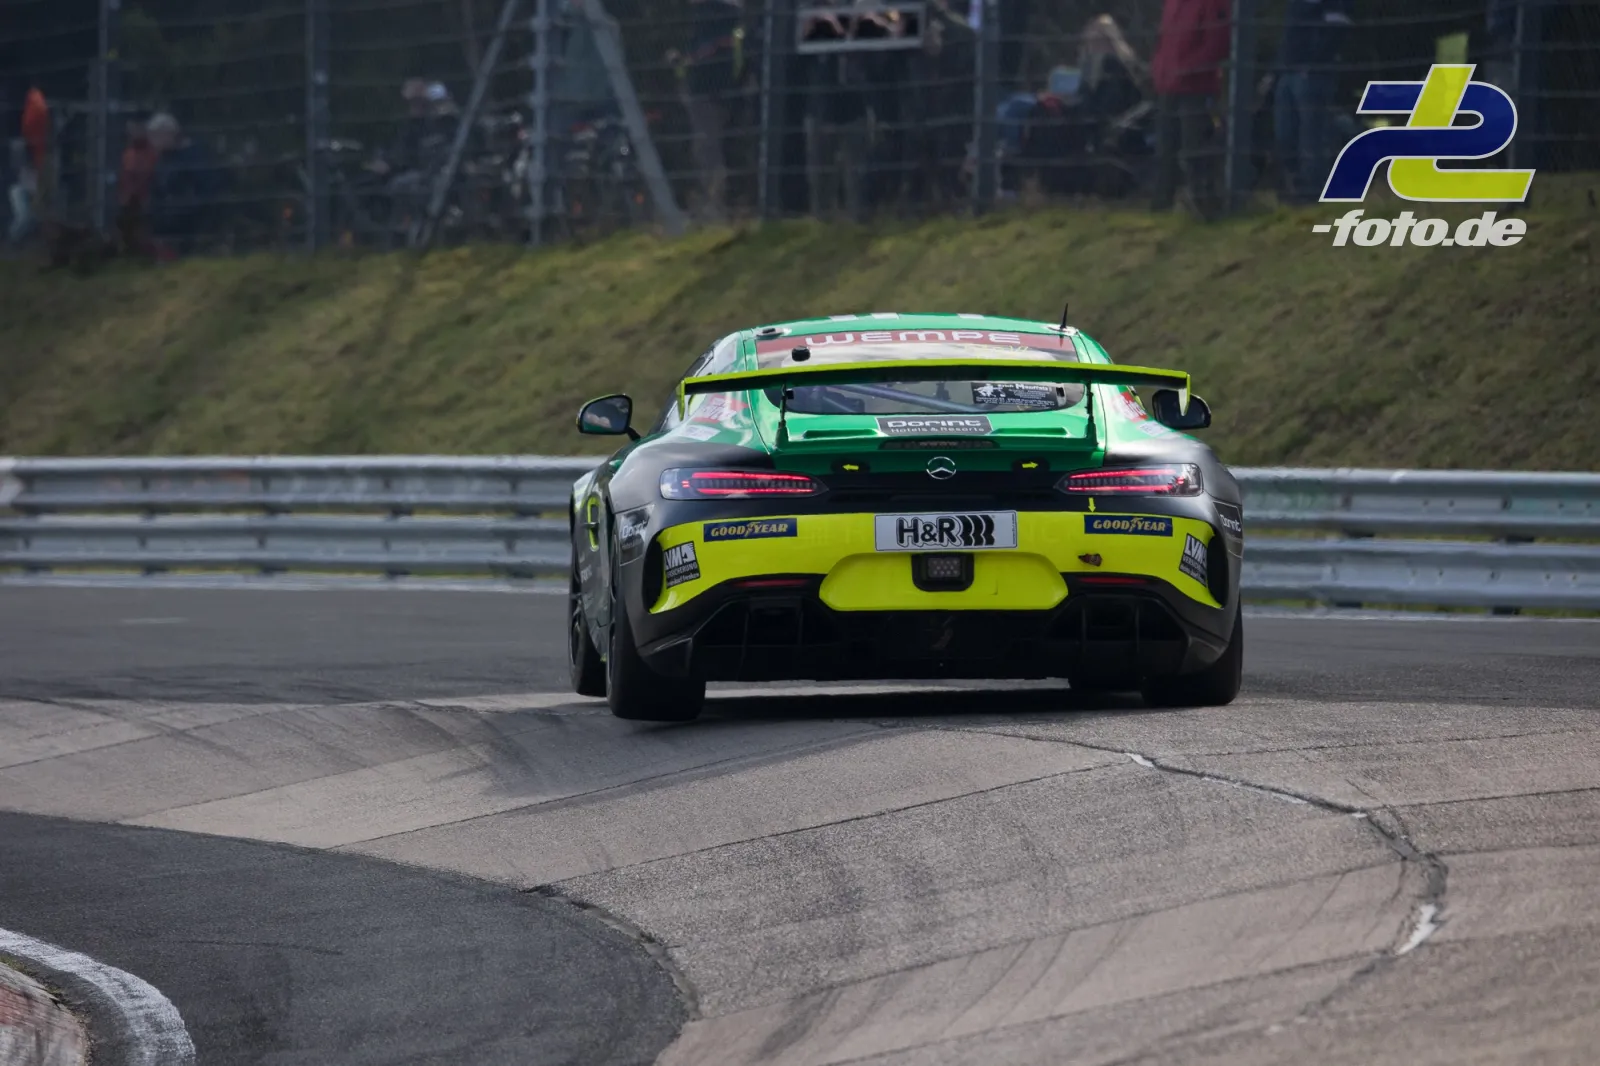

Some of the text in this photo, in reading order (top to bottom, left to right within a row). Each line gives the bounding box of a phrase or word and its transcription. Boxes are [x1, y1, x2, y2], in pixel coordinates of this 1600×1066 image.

[805, 330, 1021, 346] WEMPE
[887, 419, 981, 428] Dorint
[898, 517, 960, 546] H&R
